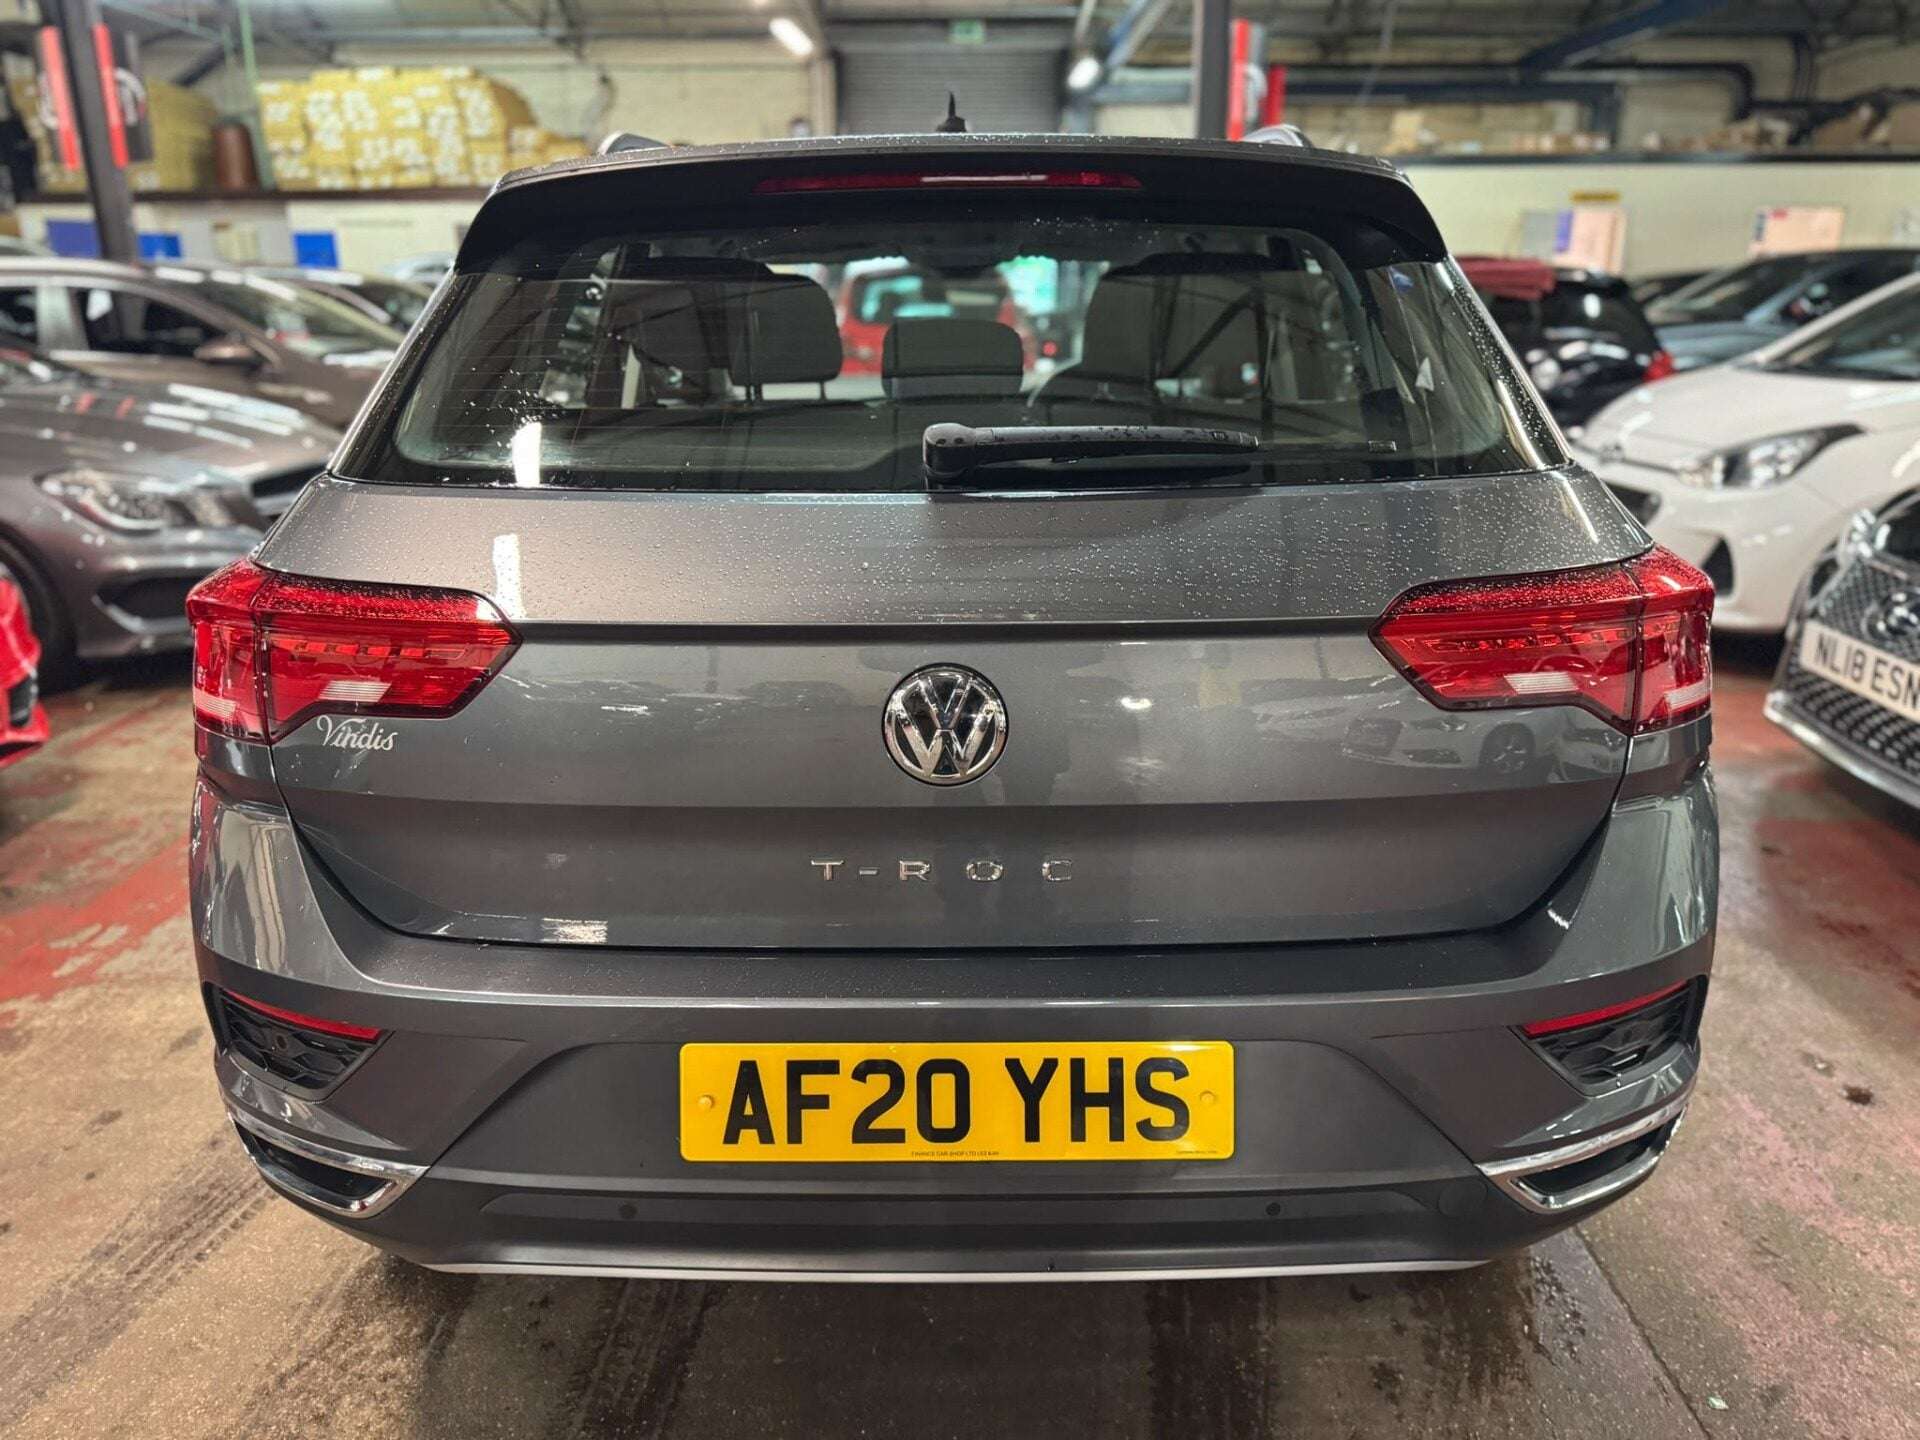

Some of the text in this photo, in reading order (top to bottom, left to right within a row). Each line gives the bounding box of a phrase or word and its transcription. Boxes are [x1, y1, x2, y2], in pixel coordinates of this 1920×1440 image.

[1815, 633, 1920, 709] NL18 ESN
[317, 715, 398, 751] Vindis
[722, 1057, 1190, 1144] AF20 YHS
